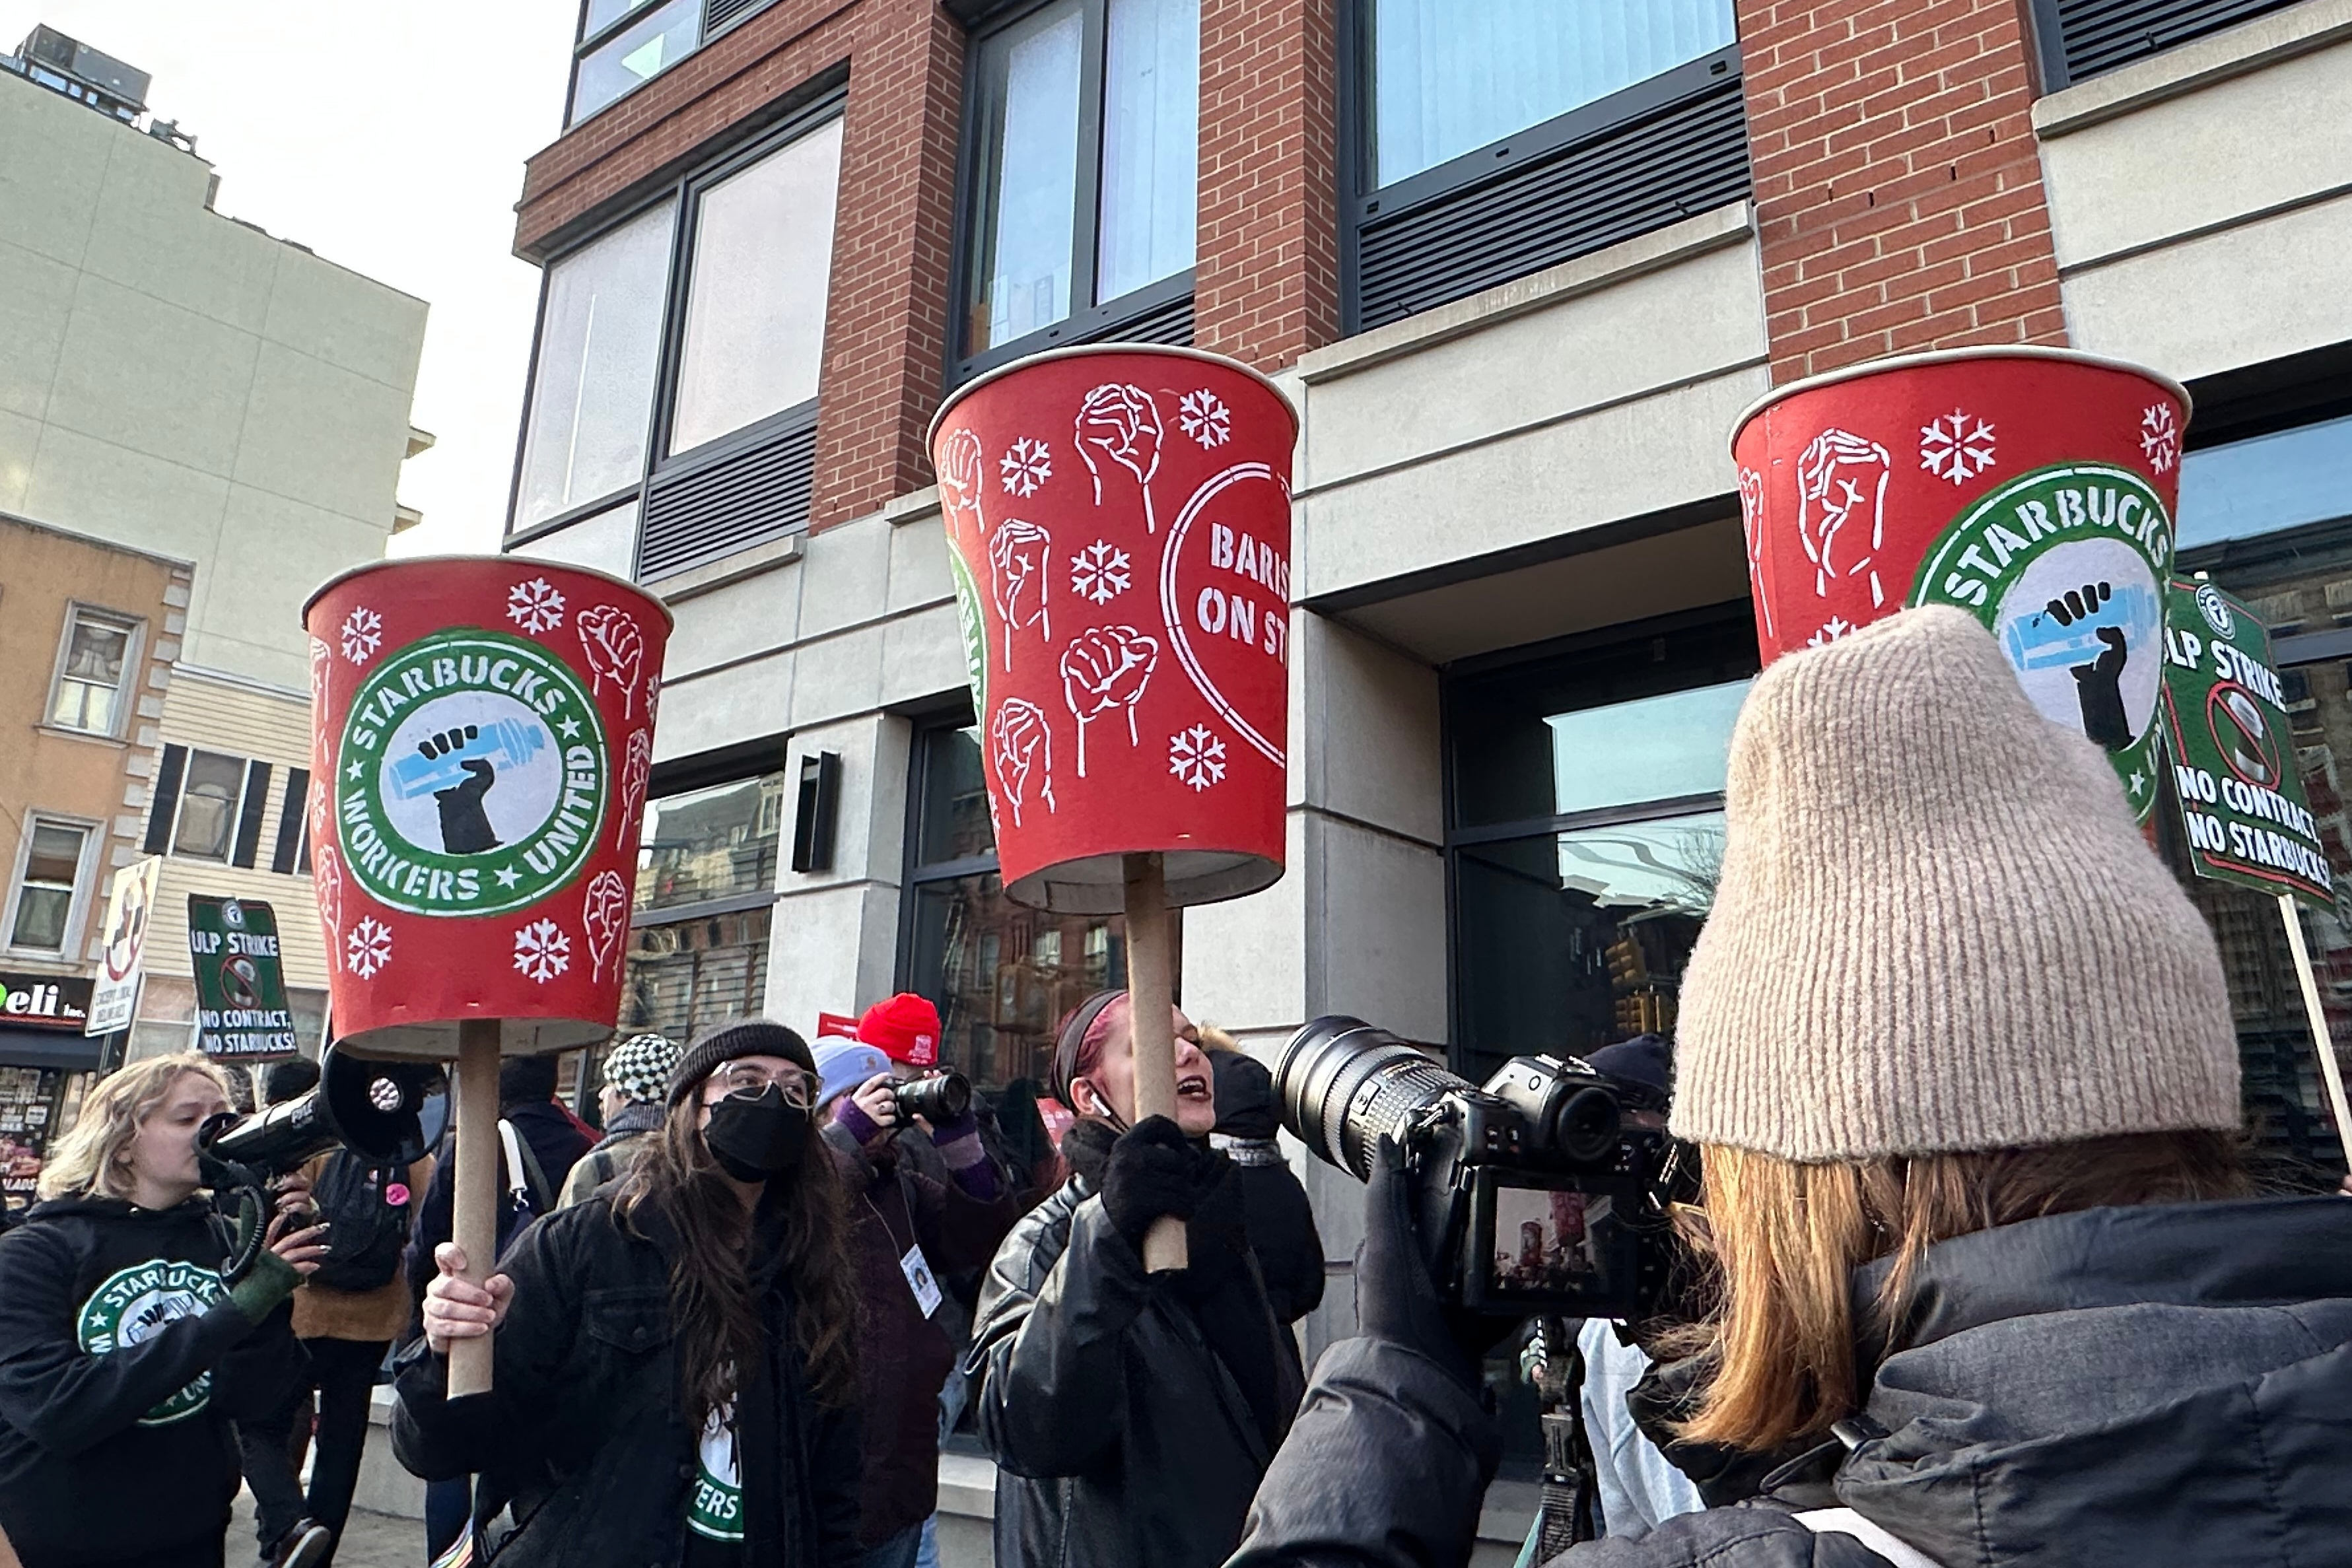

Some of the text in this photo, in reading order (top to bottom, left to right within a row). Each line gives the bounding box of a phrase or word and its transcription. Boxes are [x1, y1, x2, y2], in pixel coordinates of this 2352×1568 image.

[1945, 487, 2167, 606] STARBUCKS
[1196, 587, 1253, 644] ON
[2164, 627, 2287, 712] LP STRIKE
[353, 655, 567, 750] STARBUCKS
[2176, 765, 2217, 805] NO
[524, 745, 596, 875] UNITED
[2186, 811, 2226, 852] NO
[344, 788, 481, 901] WORKERS
[191, 930, 279, 957] ULP STRIKE
[0, 982, 59, 1015] eli
[201, 1009, 220, 1028] NO
[204, 1033, 223, 1053] NO
